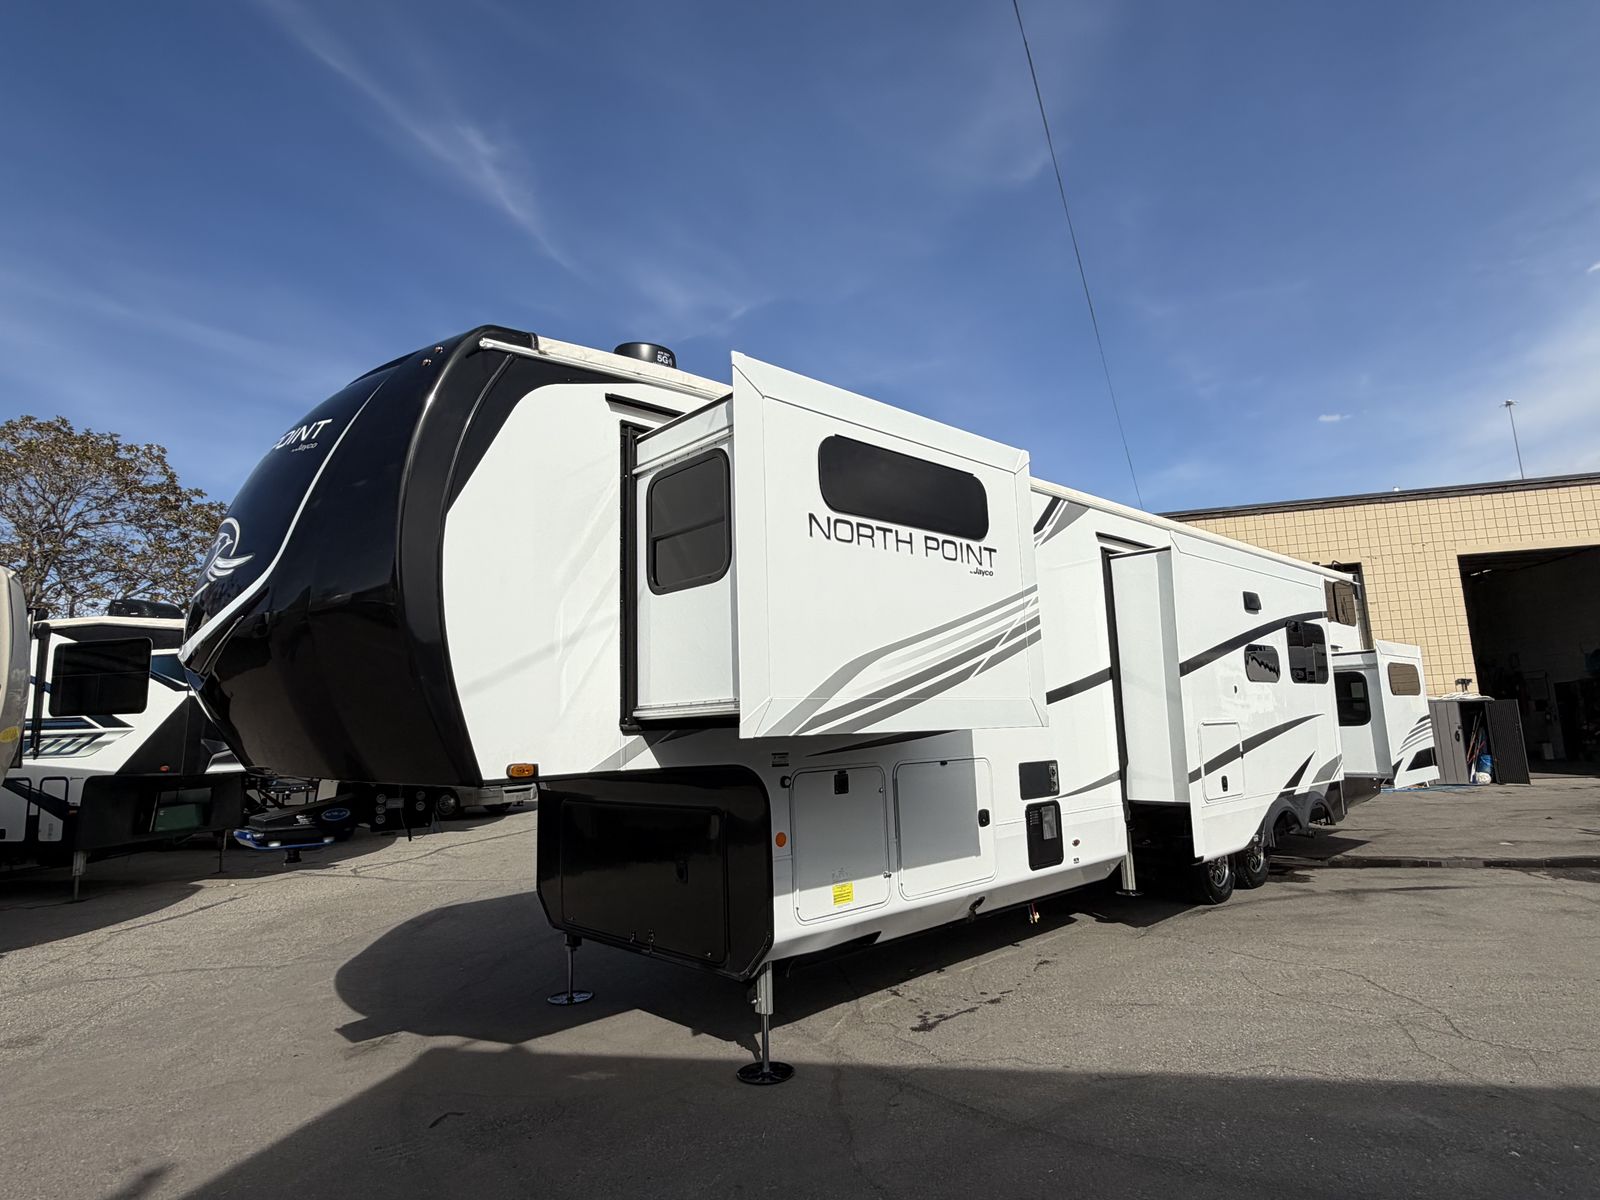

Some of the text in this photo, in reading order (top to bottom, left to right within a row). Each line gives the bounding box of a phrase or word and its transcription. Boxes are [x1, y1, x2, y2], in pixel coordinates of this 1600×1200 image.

[272, 418, 333, 450] OINT
[809, 513, 997, 567] NORTH POINT
[974, 567, 993, 576] Jayco
